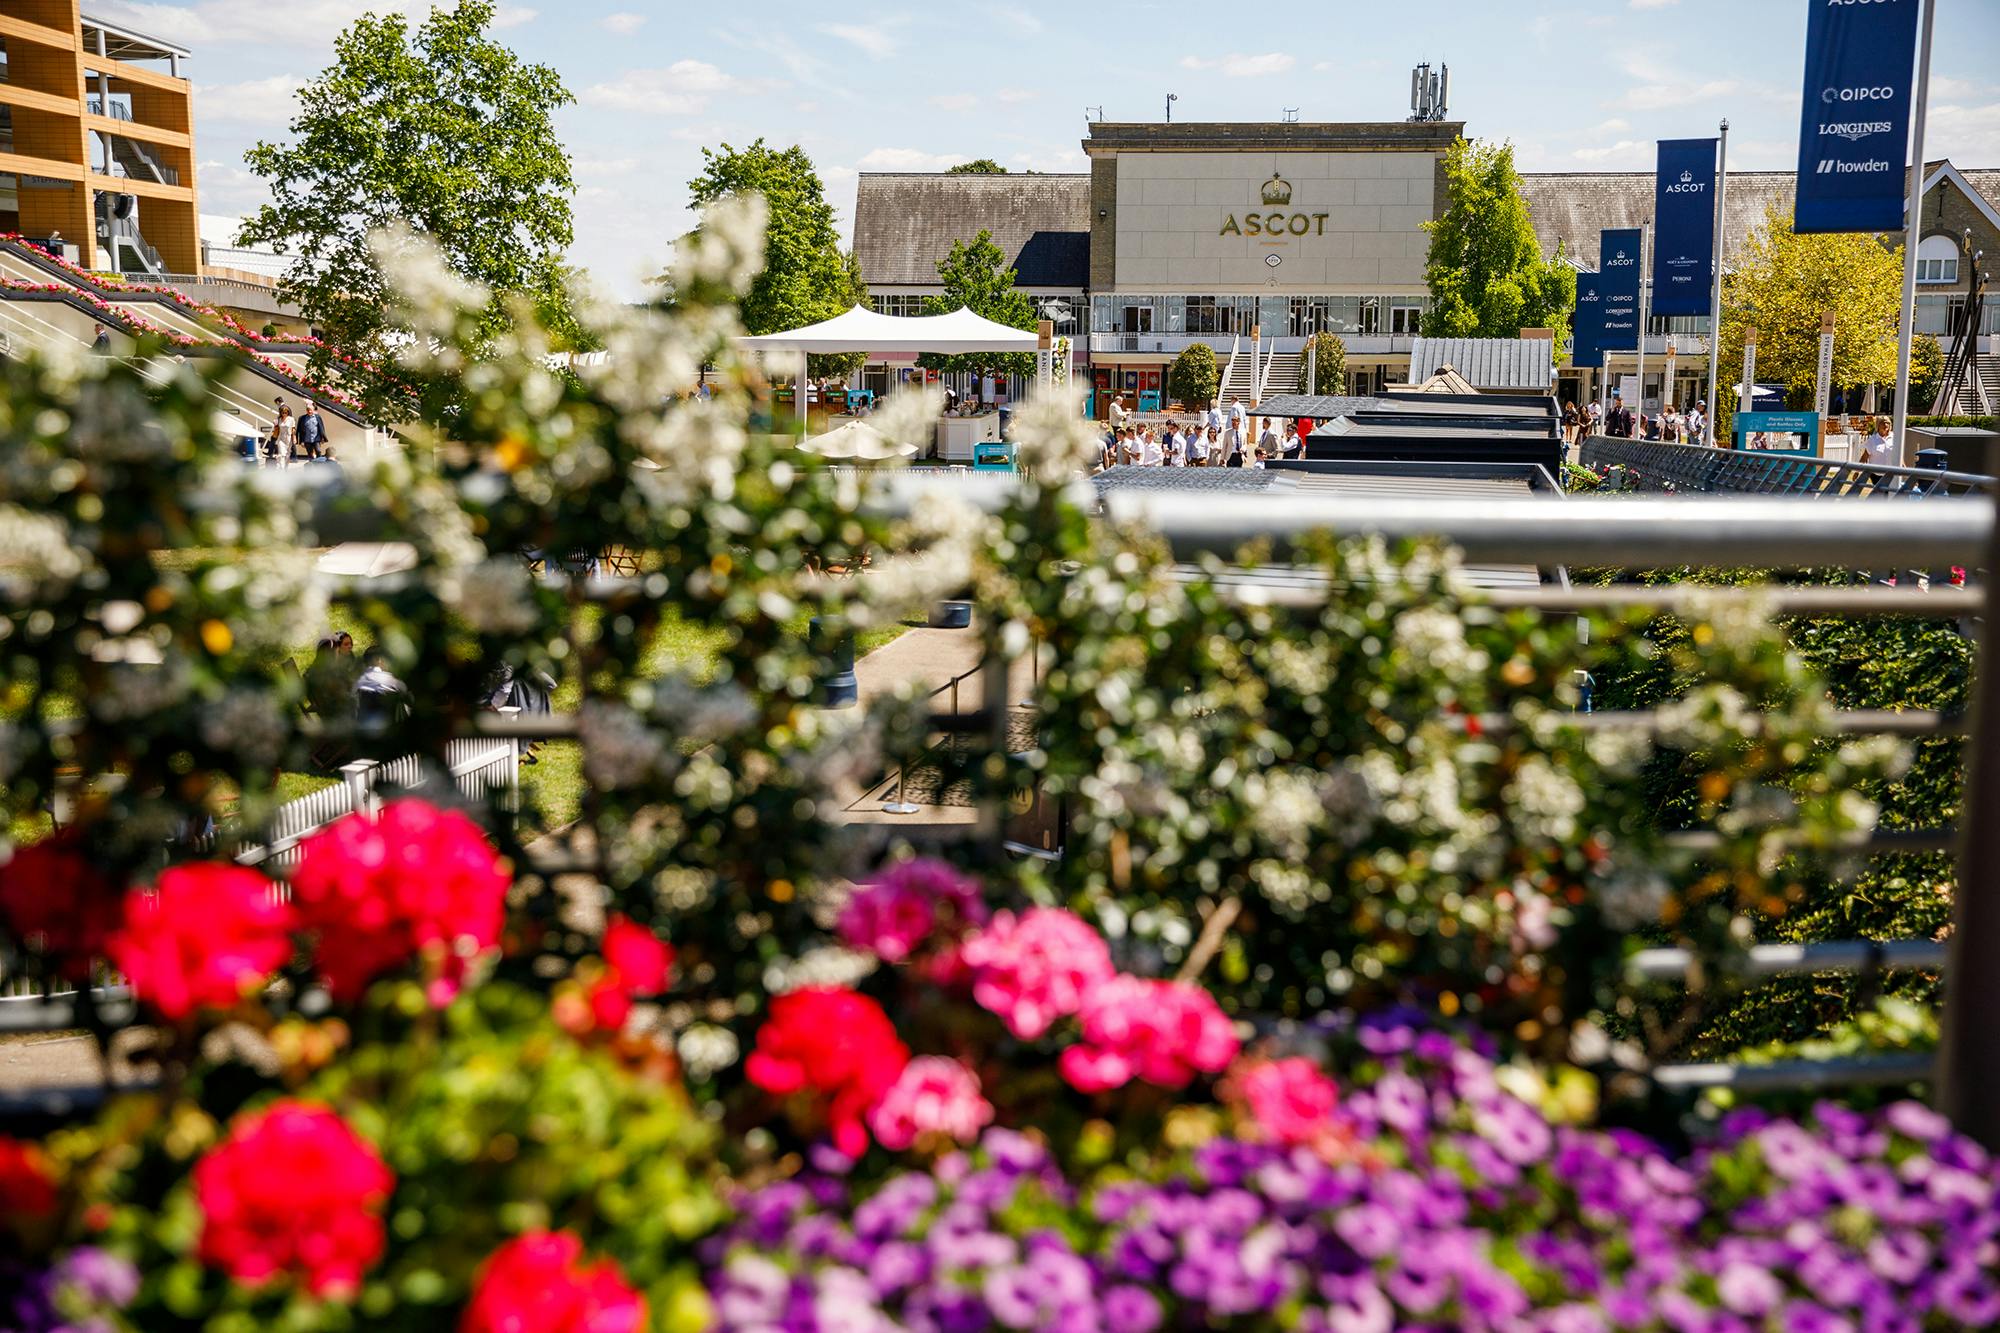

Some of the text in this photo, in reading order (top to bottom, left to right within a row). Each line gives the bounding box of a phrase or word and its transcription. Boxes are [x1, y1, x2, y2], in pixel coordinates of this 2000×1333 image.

[1840, 86, 1894, 101] QIPCO
[1818, 122, 1892, 134] LONGINES
[1836, 158, 1889, 172] howden
[1666, 184, 1705, 192] ASCOT
[1219, 213, 1329, 236] ASCOT
